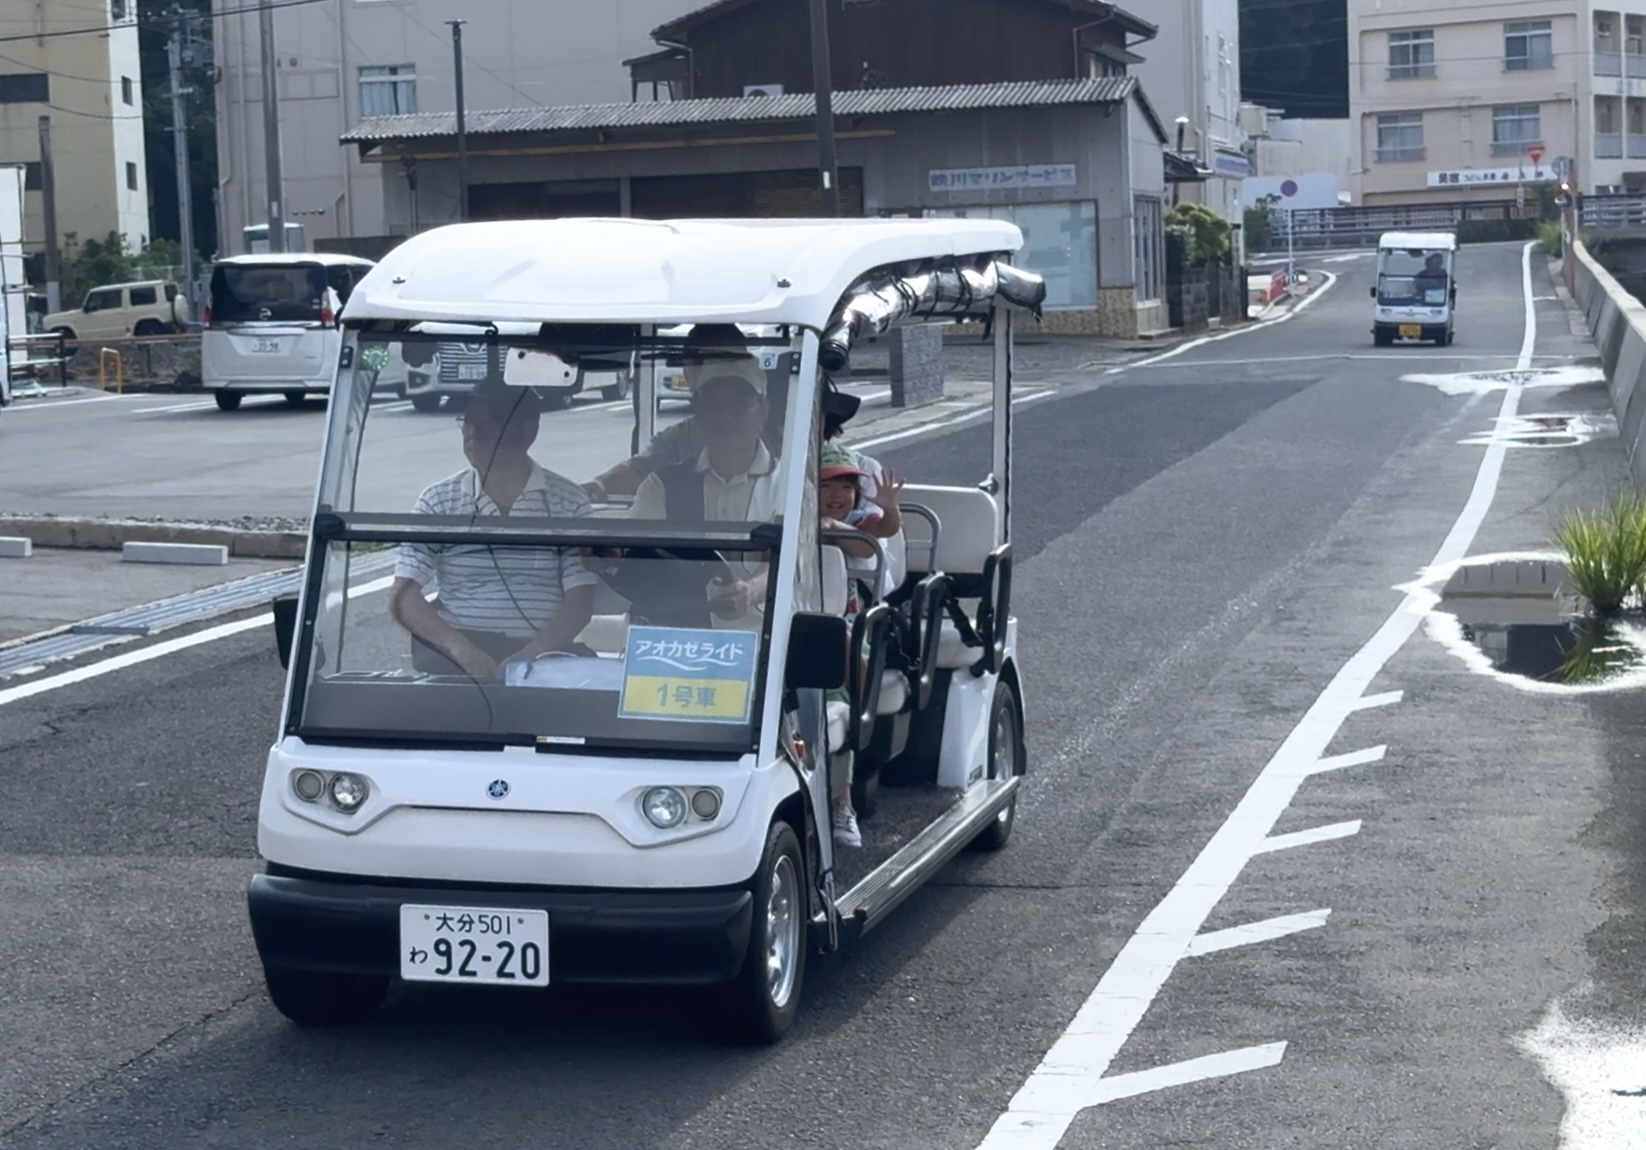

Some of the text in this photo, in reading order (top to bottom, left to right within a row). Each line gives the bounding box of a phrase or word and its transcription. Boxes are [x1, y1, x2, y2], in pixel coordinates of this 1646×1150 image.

[635, 639, 743, 660] アオカゼライド
[657, 683, 717, 708] 1号車
[409, 937, 541, 980] わ 92-20
